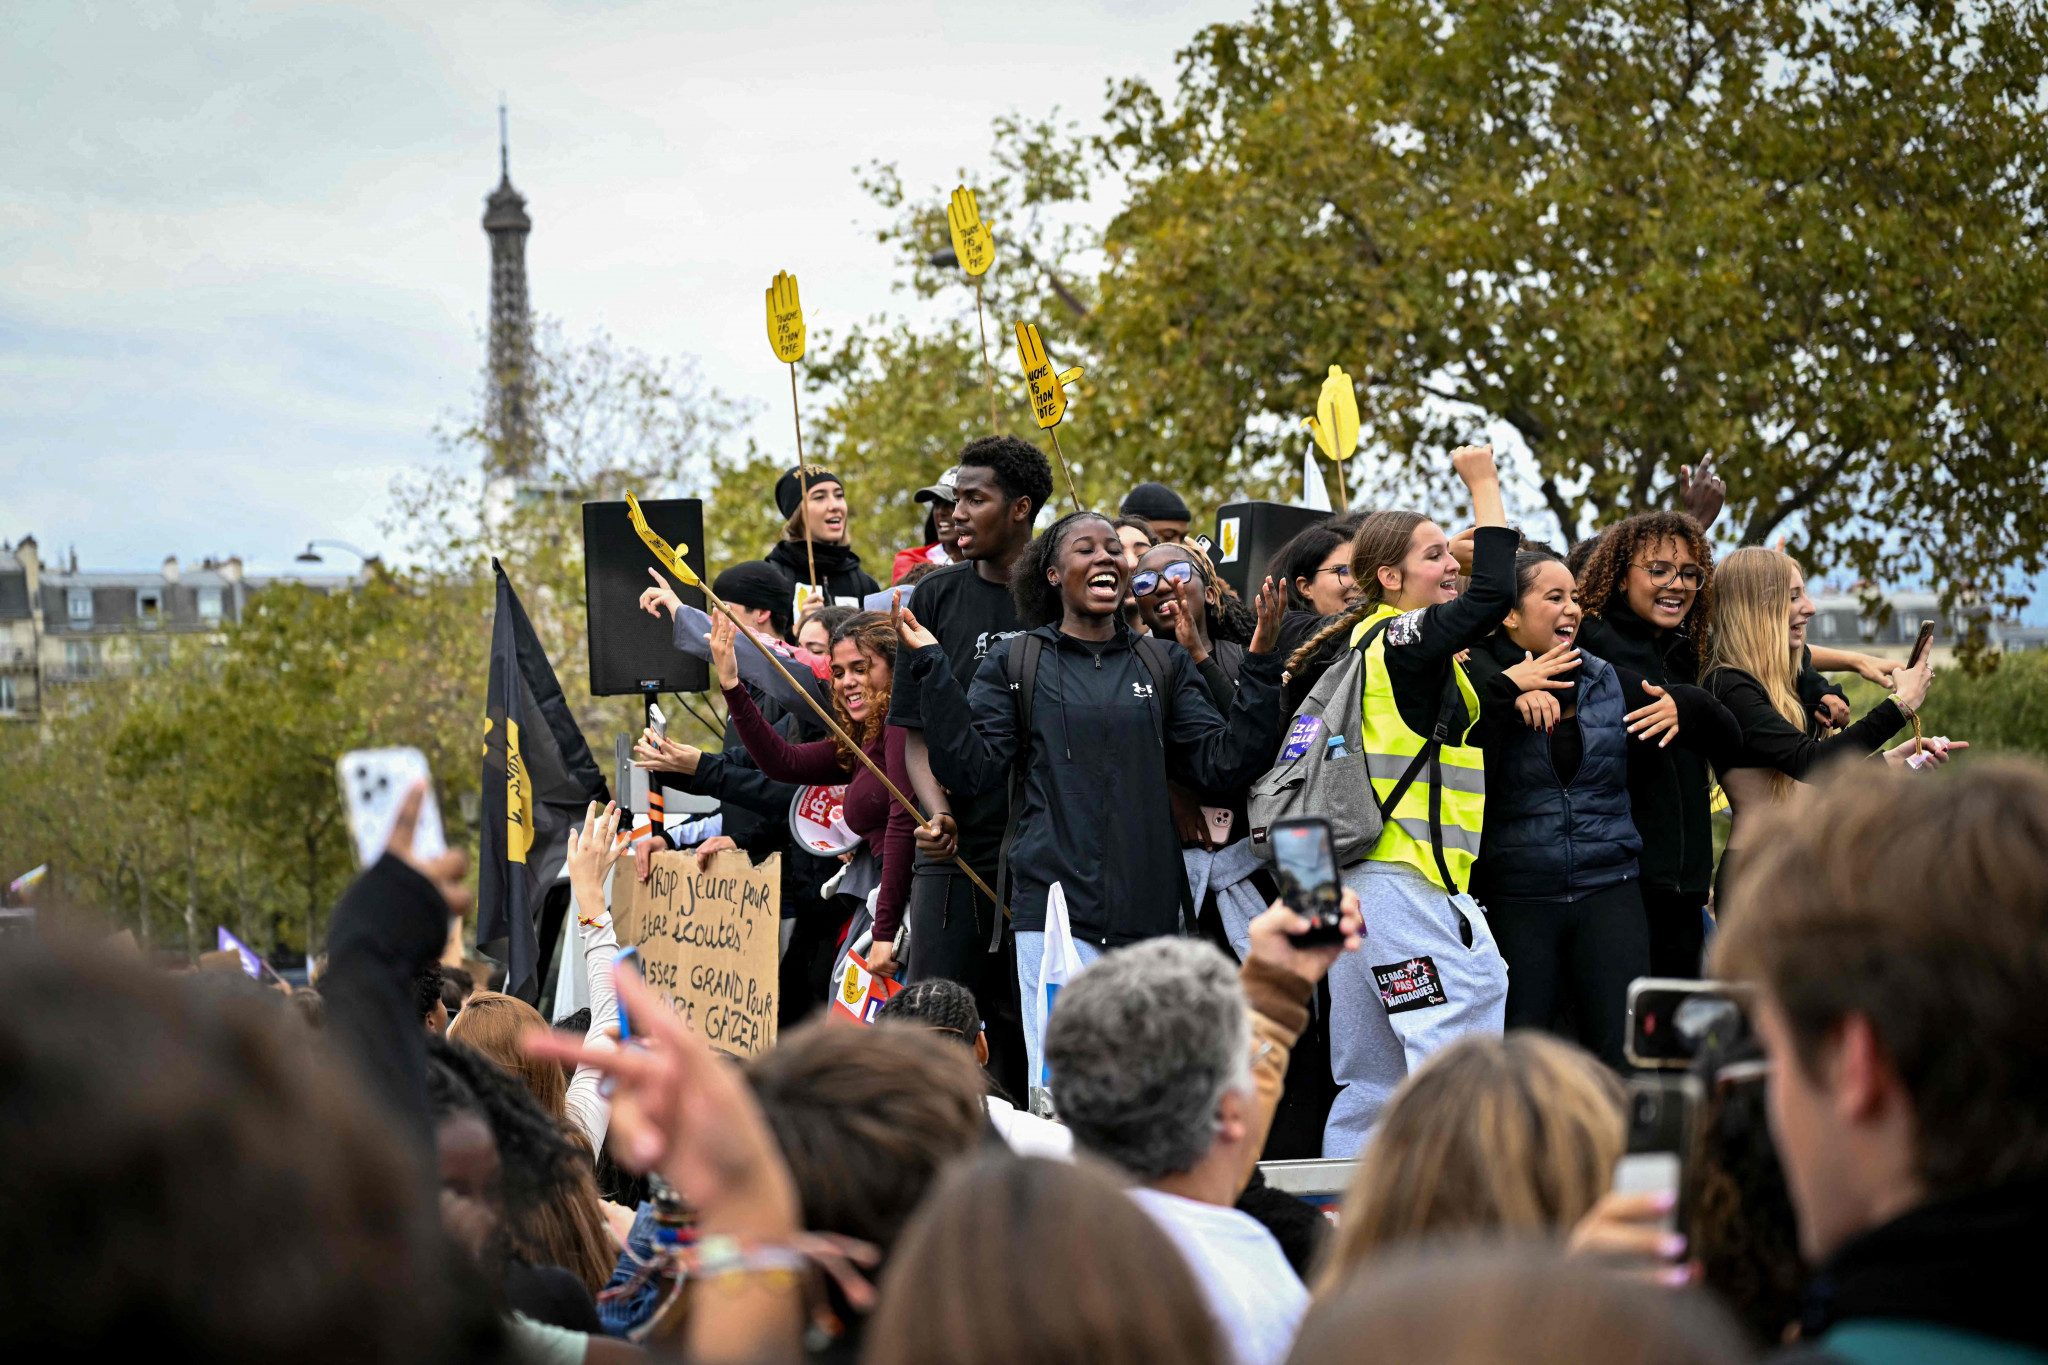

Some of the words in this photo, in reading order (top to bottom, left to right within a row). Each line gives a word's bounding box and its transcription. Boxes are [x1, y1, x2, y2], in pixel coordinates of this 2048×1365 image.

[775, 309, 799, 323] TOUCHE
[777, 322, 790, 334] PAS
[780, 342, 799, 356] POTE
[691, 965, 744, 1005] GRAND
[1378, 974, 1389, 985] LE
[1394, 980, 1414, 991] PAS
[1413, 974, 1430, 988] LES
